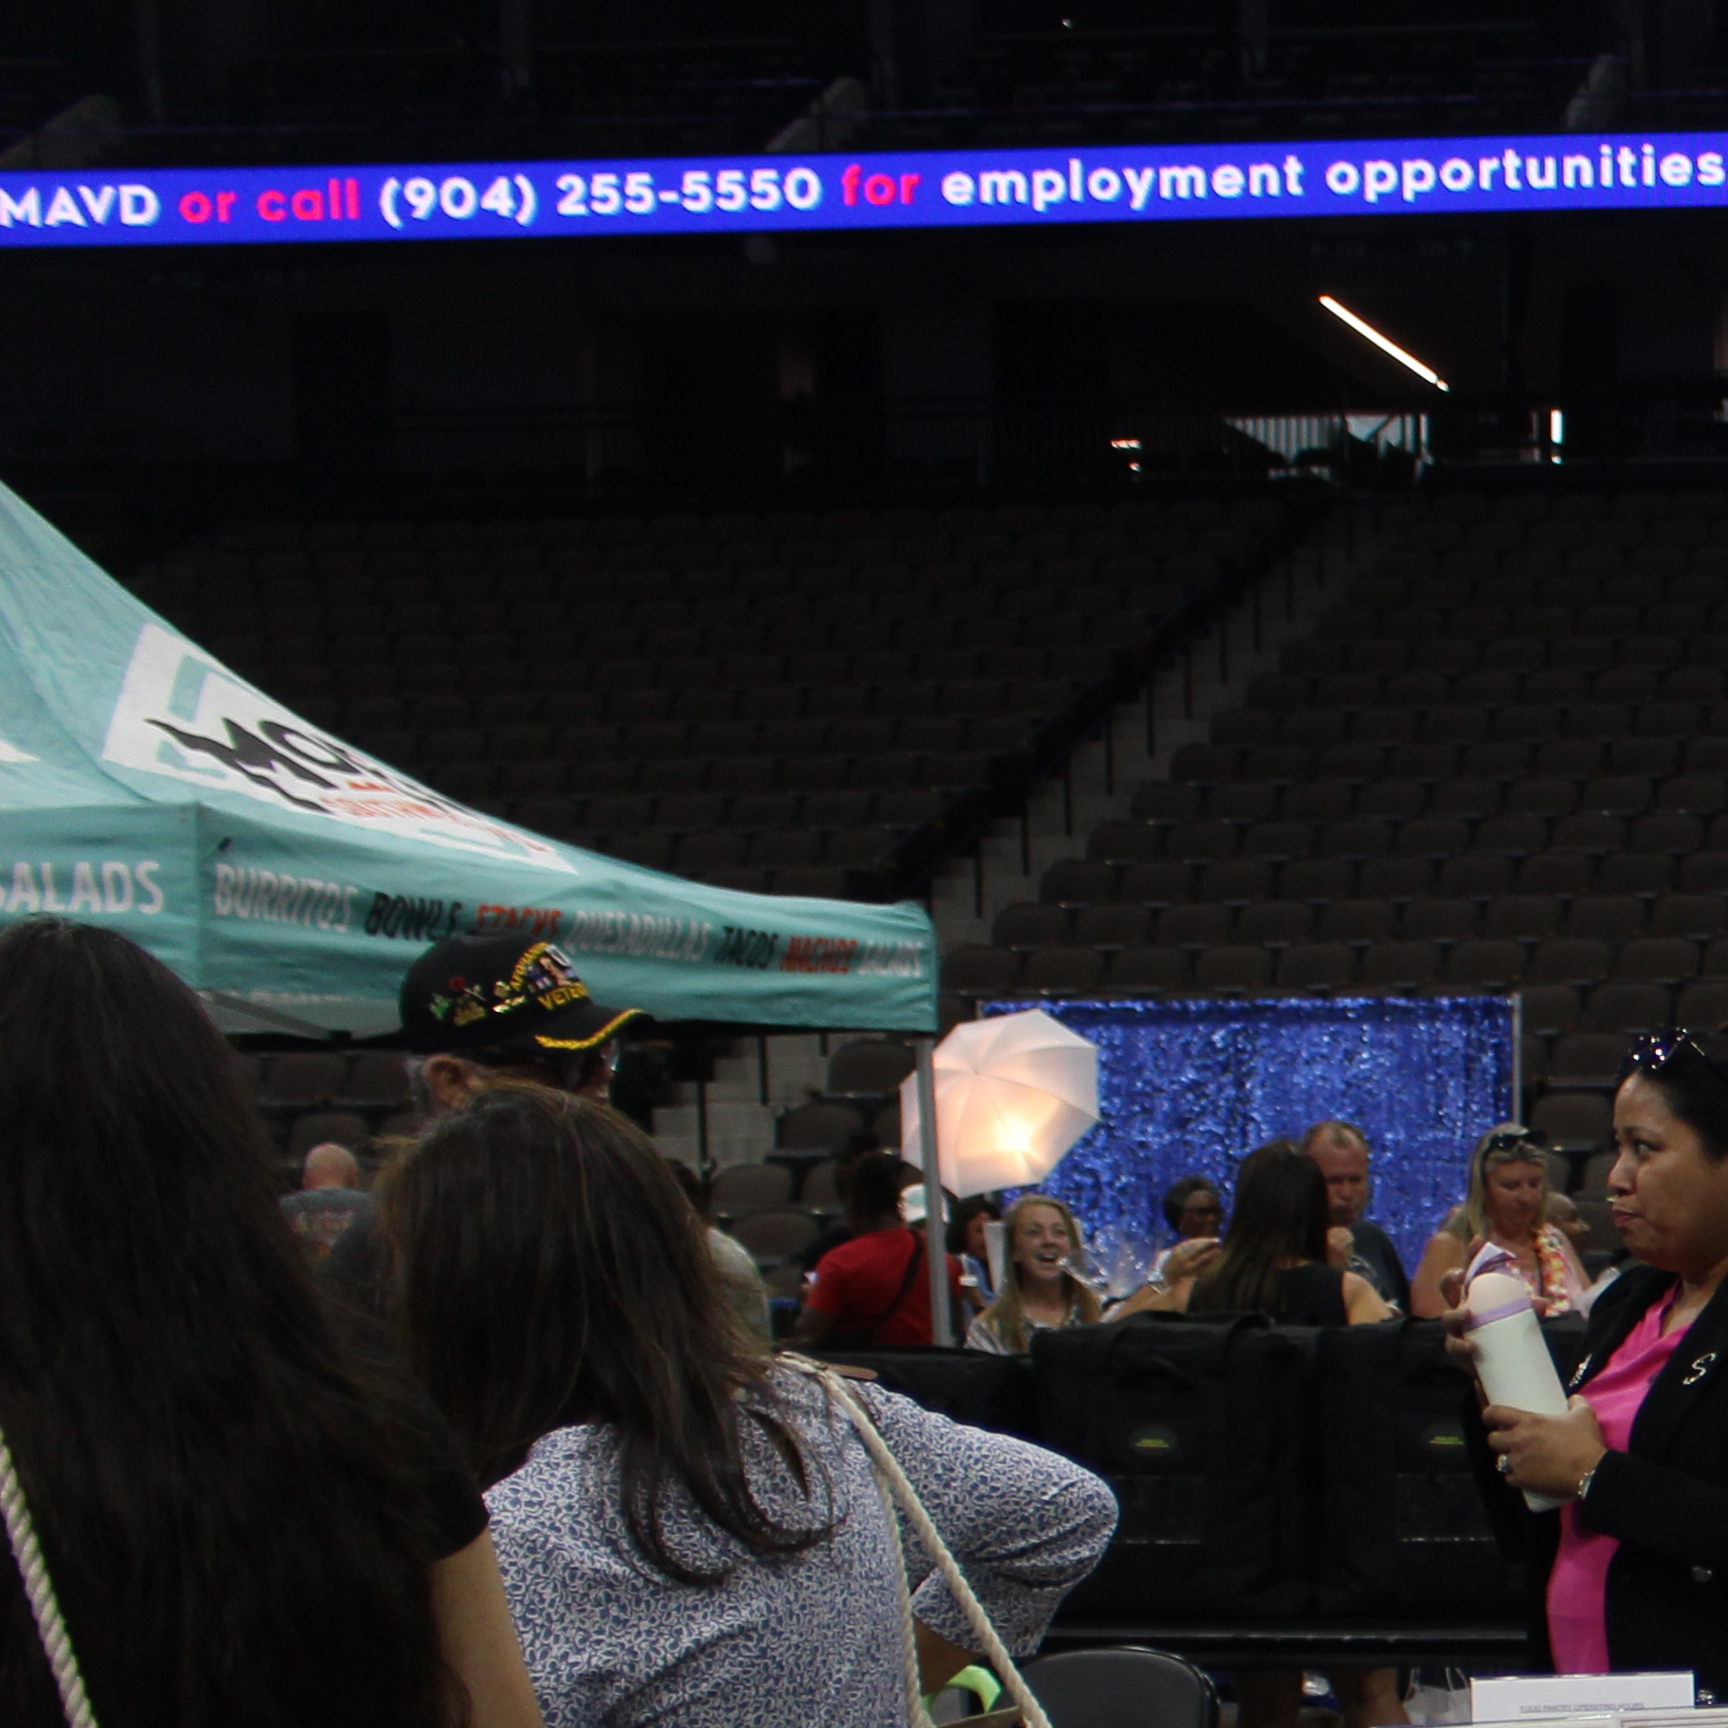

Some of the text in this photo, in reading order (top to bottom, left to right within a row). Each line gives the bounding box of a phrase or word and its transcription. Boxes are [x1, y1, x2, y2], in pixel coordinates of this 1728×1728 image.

[0, 184, 158, 229] MAVD
[179, 186, 236, 224] or
[256, 177, 361, 223] call
[380, 175, 538, 230] (904)
[556, 168, 823, 218] 255-5550
[841, 165, 919, 207] for
[942, 155, 1304, 210] employment
[0, 860, 164, 915] ALADS
[214, 862, 358, 934] BURRITOS
[563, 909, 711, 962] QUESADILLAS
[713, 926, 781, 970] TACOS
